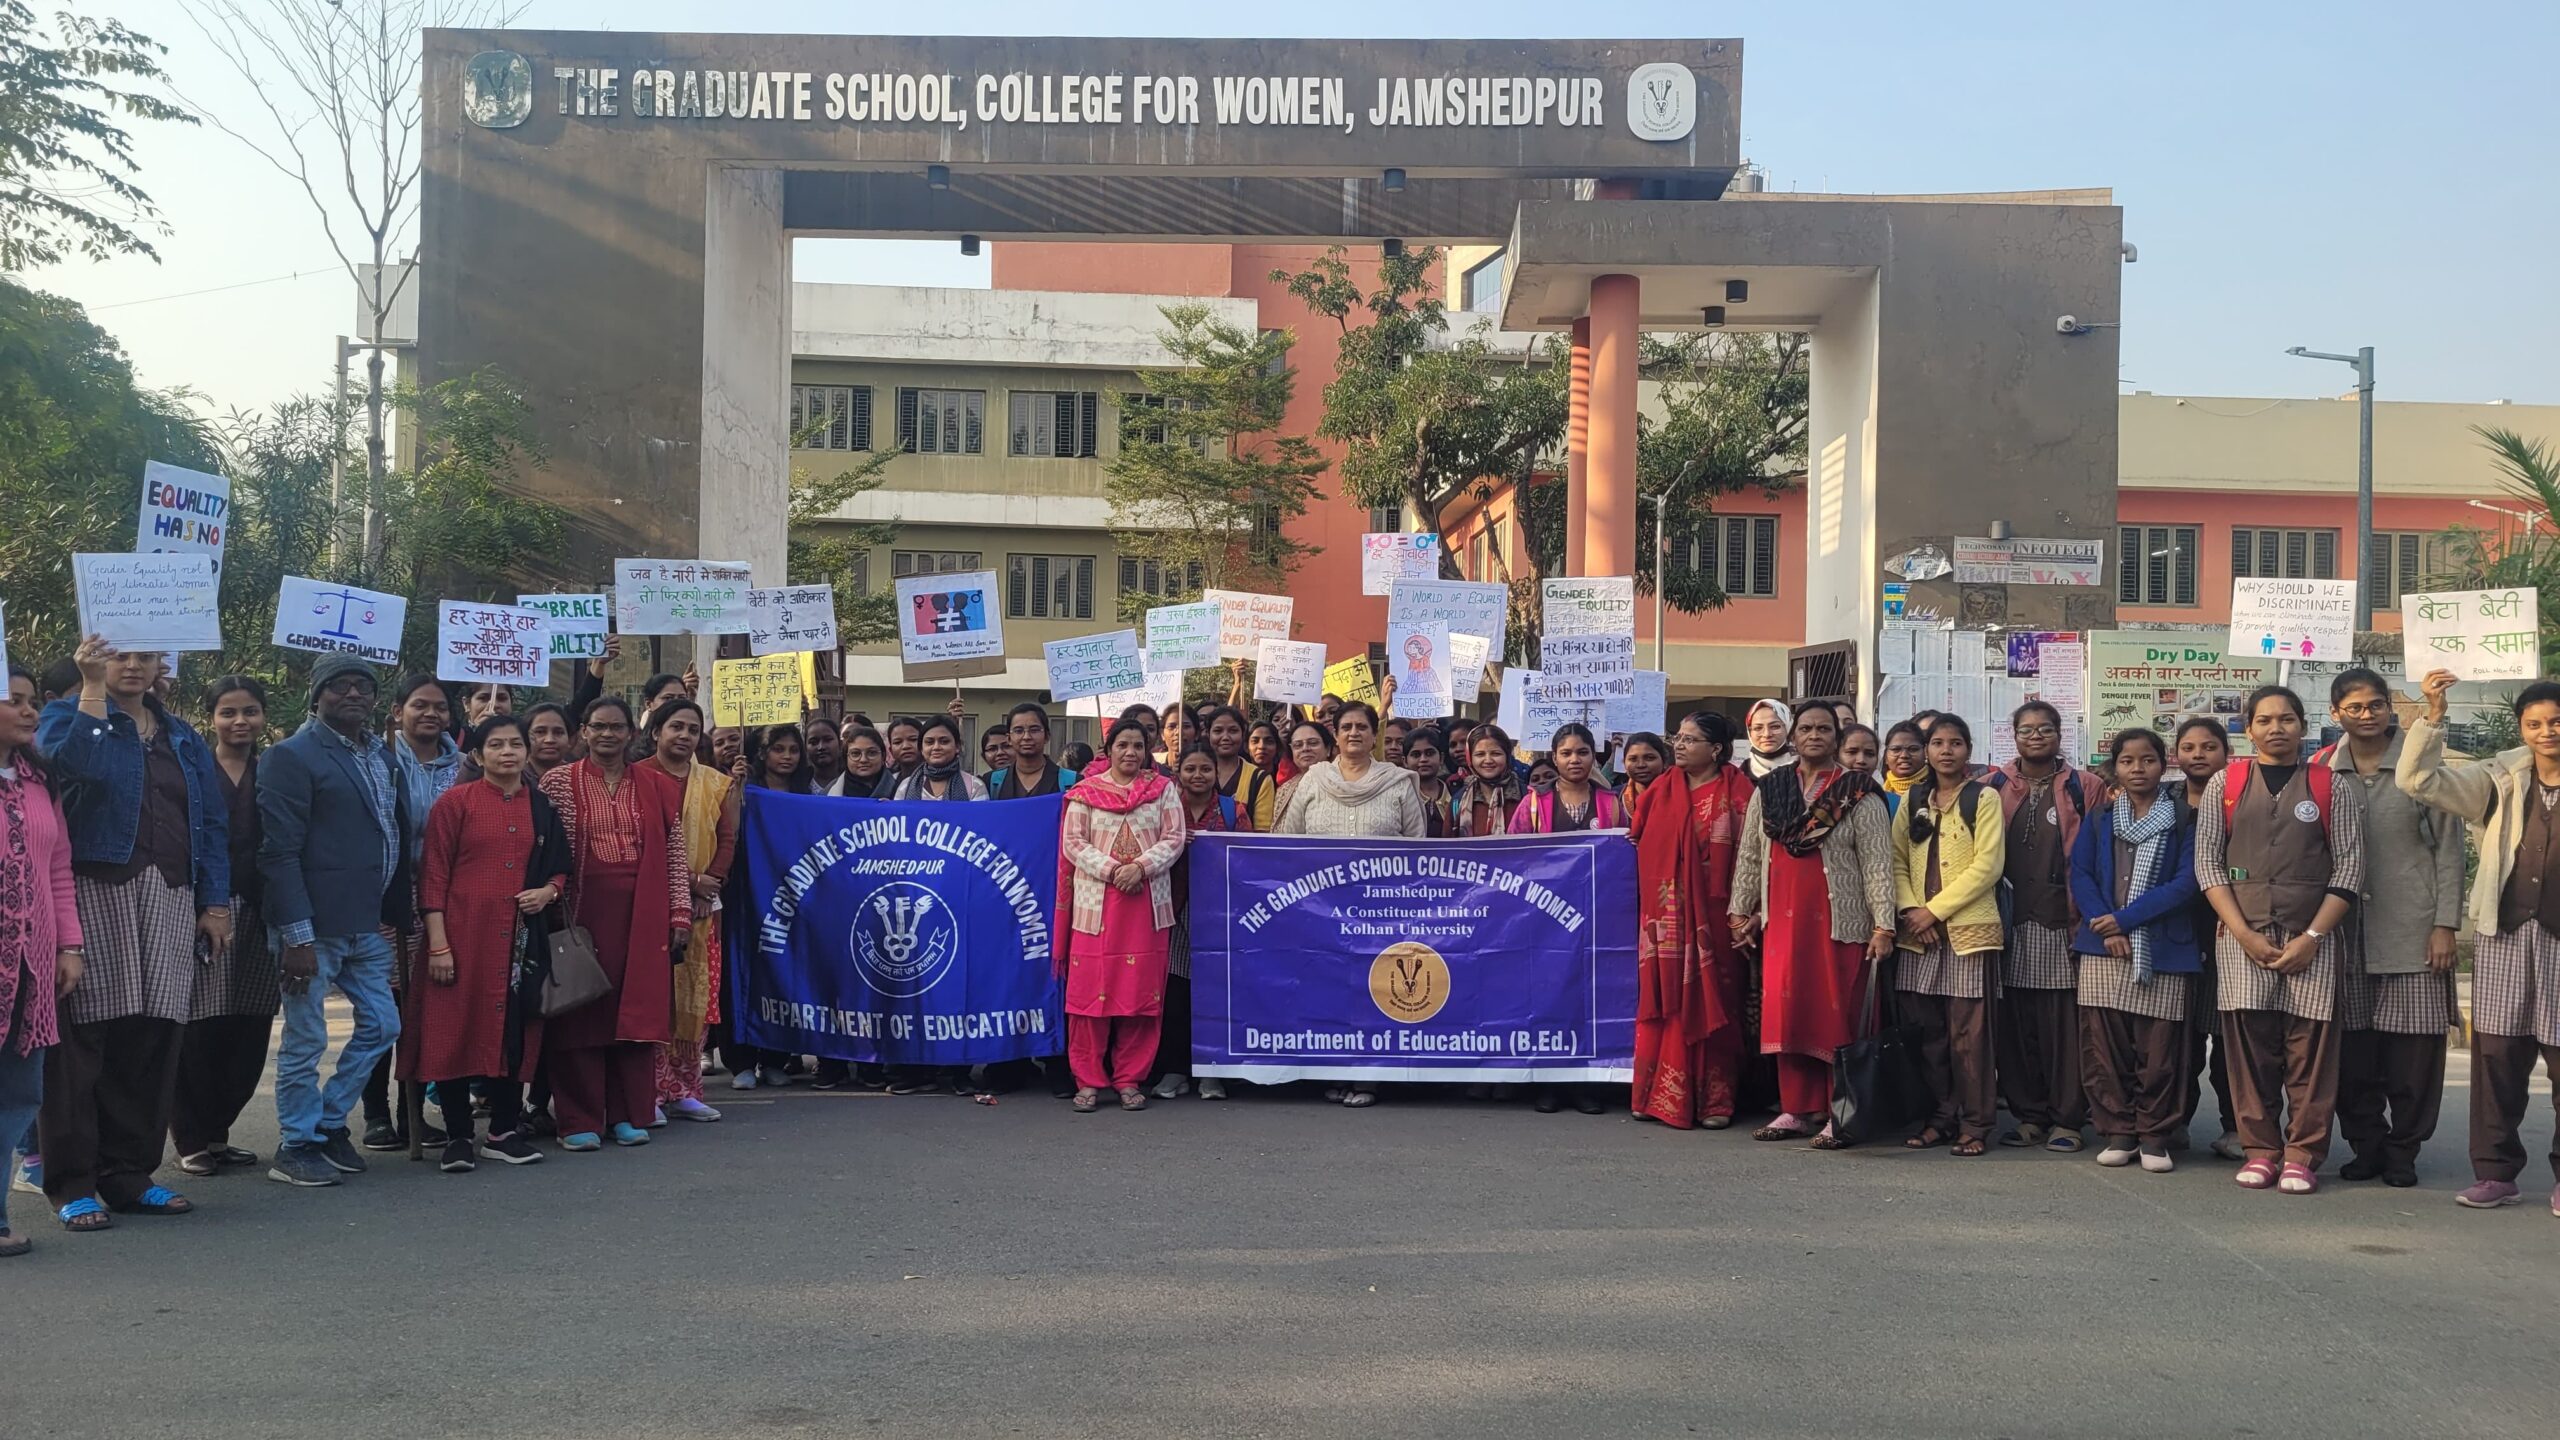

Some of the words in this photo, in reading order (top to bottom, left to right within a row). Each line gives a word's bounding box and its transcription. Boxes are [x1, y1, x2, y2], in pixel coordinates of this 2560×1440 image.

[553, 67, 619, 117] THE
[632, 69, 811, 121] GRADUATE
[825, 73, 967, 132] SCHOOL,
[977, 75, 1122, 125] COLLEGE
[1134, 77, 1199, 125] FOR
[1213, 77, 1354, 135] WOMEN,
[1369, 77, 1604, 128] JAMSHEDPUR
[147, 480, 228, 519] EQUALITY
[154, 513, 195, 541] HAS
[197, 522, 220, 546] NO
[2013, 542, 2095, 556] INFOTECH
[87, 560, 127, 575] Gender
[133, 561, 177, 581] Equality
[181, 562, 203, 575] not
[672, 565, 697, 583] नारी
[89, 579, 117, 596] only
[121, 578, 169, 589] liberates
[174, 580, 210, 589] women
[1395, 588, 1403, 601] A
[1412, 590, 1443, 603] WORLD
[1450, 592, 1462, 602] OF
[1545, 584, 1595, 599] GENDER
[2238, 582, 2265, 594] WHY
[2267, 582, 2314, 595] SHOULD
[2323, 585, 2345, 597] WE
[1433, 608, 1466, 620] WORLD
[2258, 597, 2351, 612] DISCRIMINATE
[2417, 594, 2461, 623] बेटा
[2479, 591, 2524, 620] बेटी
[449, 608, 470, 625] हर
[286, 633, 336, 652] GENDER
[339, 641, 399, 660] EQUALITY
[2429, 635, 2467, 653] एक
[2477, 631, 2536, 659] समान
[2146, 648, 2178, 664] Dry
[2184, 648, 2220, 664] Day
[2104, 662, 2152, 681] अबकी
[2231, 667, 2263, 682] मार
[2131, 692, 2151, 700] FEVER
[839, 815, 911, 854] SCHOOL
[915, 816, 998, 869] COLLEGE
[771, 833, 844, 919] GRADUATE
[851, 858, 946, 876] JAMSHEDPUR
[988, 850, 1019, 892] FOR
[1239, 902, 1273, 936] THE
[1266, 864, 1348, 914] GRADUATE
[1351, 855, 1413, 883] SCHOOL
[1416, 855, 1488, 884] COLLEGE
[1490, 867, 1525, 894] FOR
[1524, 880, 1586, 934] WOMEN
[1362, 884, 1456, 901] Jamshedpur
[1004, 878, 1050, 962] WOMEN
[1331, 906, 1343, 918] A
[1347, 905, 1434, 918] Constituent
[1437, 905, 1470, 918] Unit
[1473, 905, 1489, 918] of
[758, 912, 792, 955] THE
[1340, 922, 1394, 936] Kolhan
[1399, 923, 1476, 938] University
[761, 996, 883, 1040] DEPARTMENT
[890, 1014, 914, 1041] OF
[924, 1008, 1046, 1041] EDUCATION
[1246, 1027, 1364, 1054] Department
[1372, 1029, 1392, 1051] of
[1399, 1028, 1501, 1051] Education
[1509, 1029, 1578, 1056] (B.Ed.)
